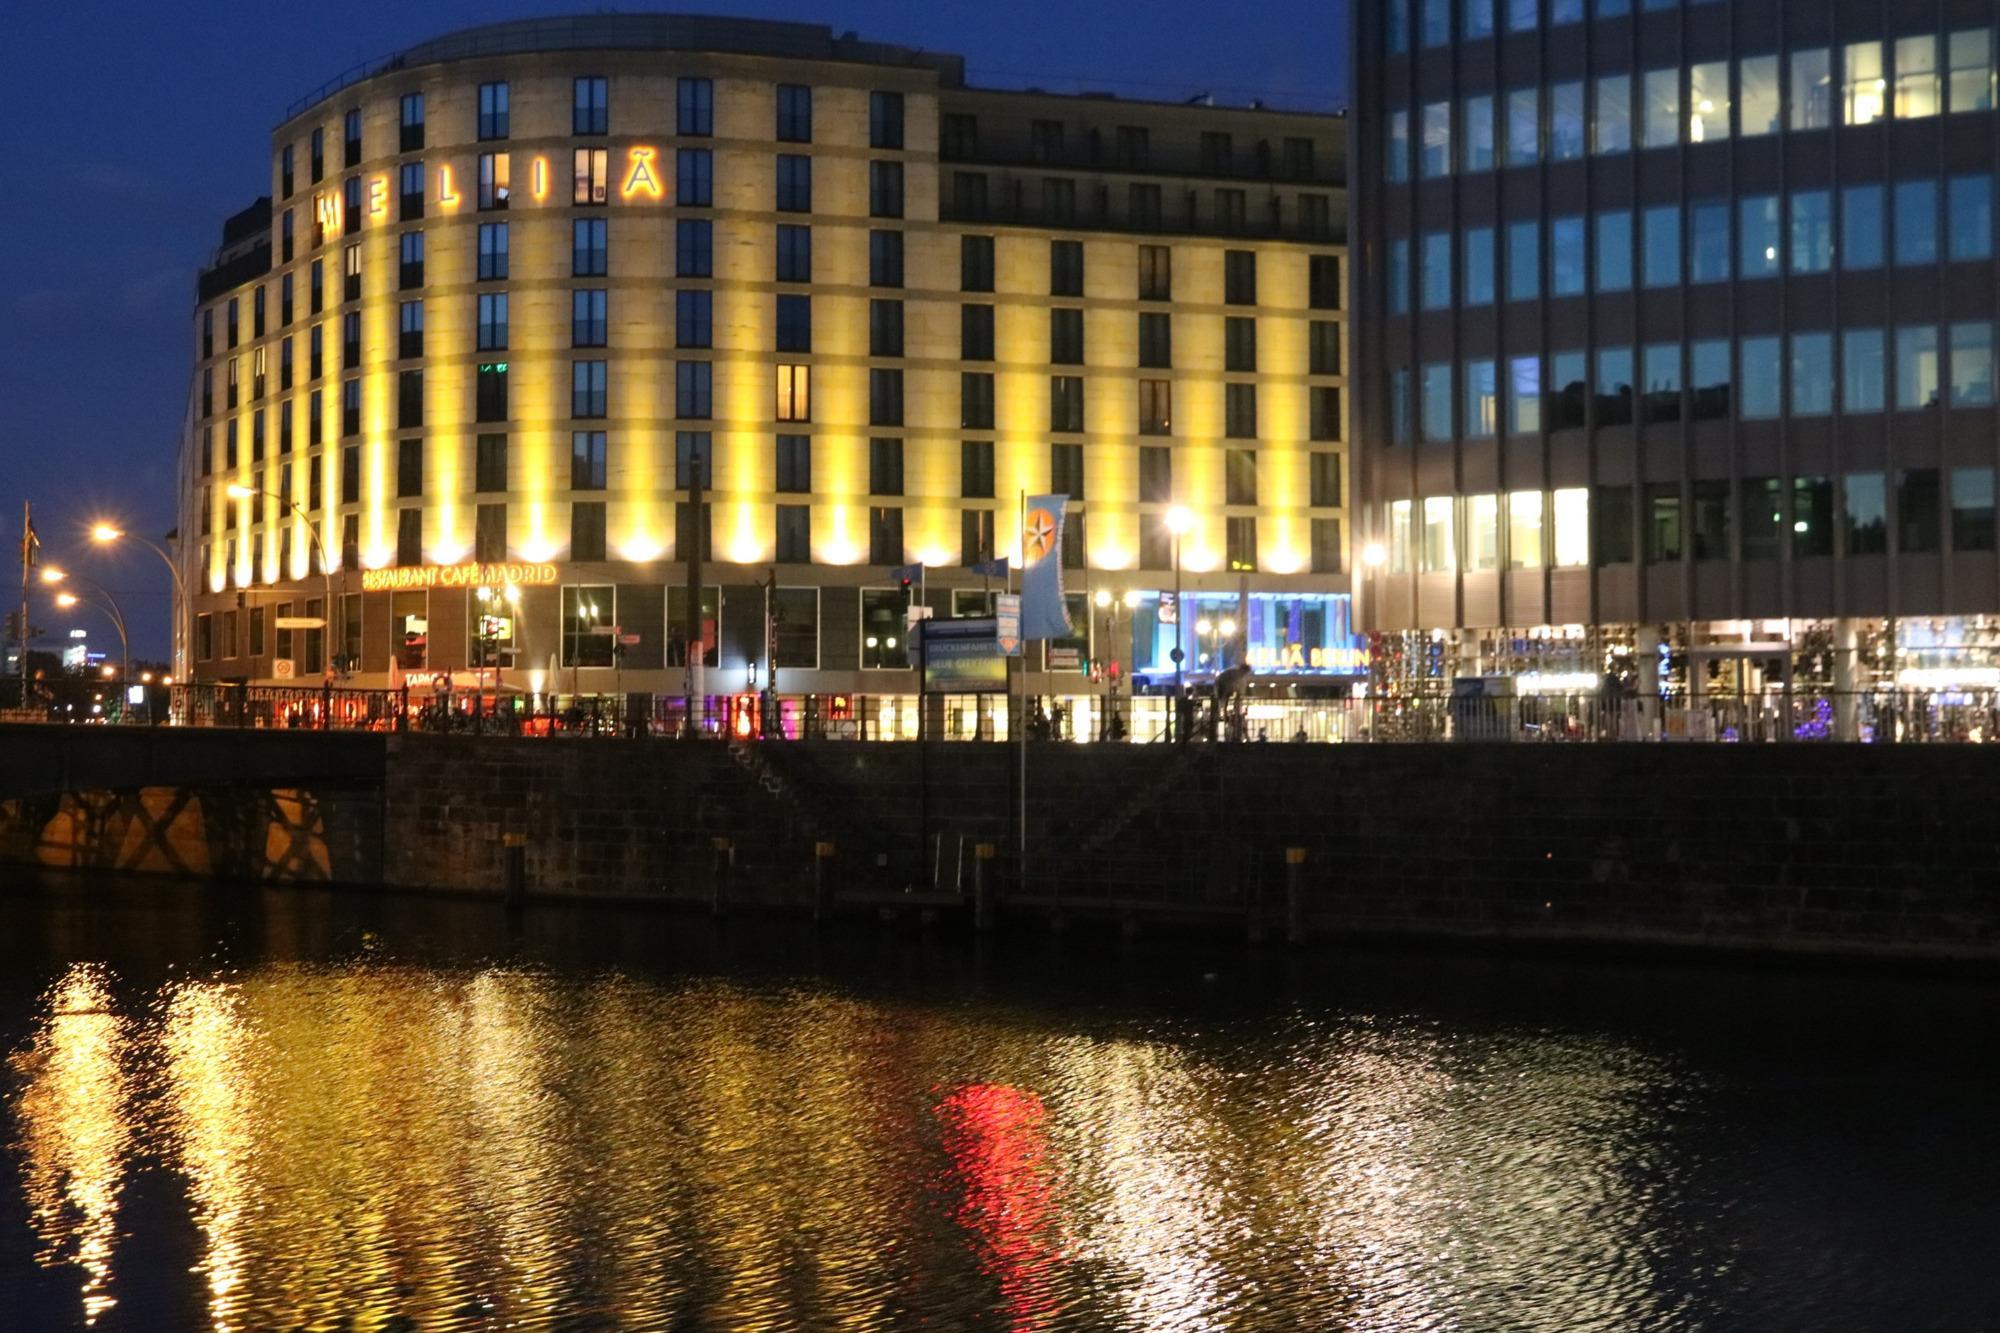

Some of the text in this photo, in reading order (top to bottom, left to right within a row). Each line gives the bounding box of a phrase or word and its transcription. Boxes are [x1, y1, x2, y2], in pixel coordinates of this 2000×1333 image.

[362, 562, 557, 590] RESTAURANT CAFÉ MADRID
[1310, 647, 1370, 667] BERLIN
